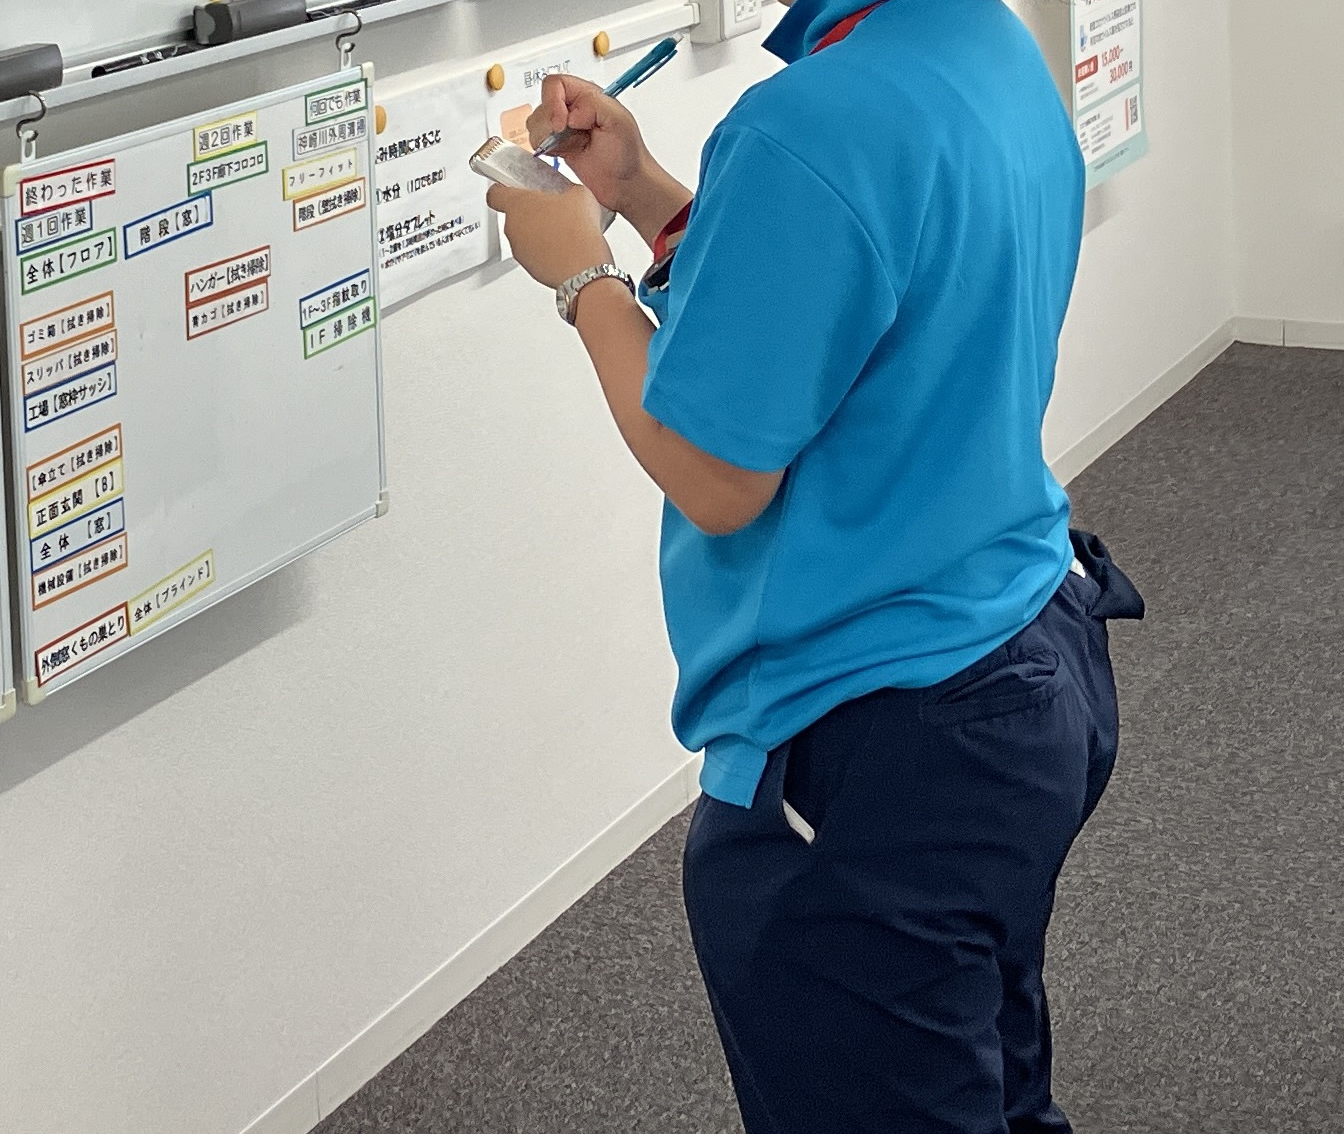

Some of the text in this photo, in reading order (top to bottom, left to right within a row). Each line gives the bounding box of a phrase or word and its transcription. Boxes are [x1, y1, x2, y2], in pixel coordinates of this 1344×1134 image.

[199, 120, 254, 151] 週2回作業
[26, 168, 112, 207] 終わった作業
[21, 207, 86, 244] 週1回作業
